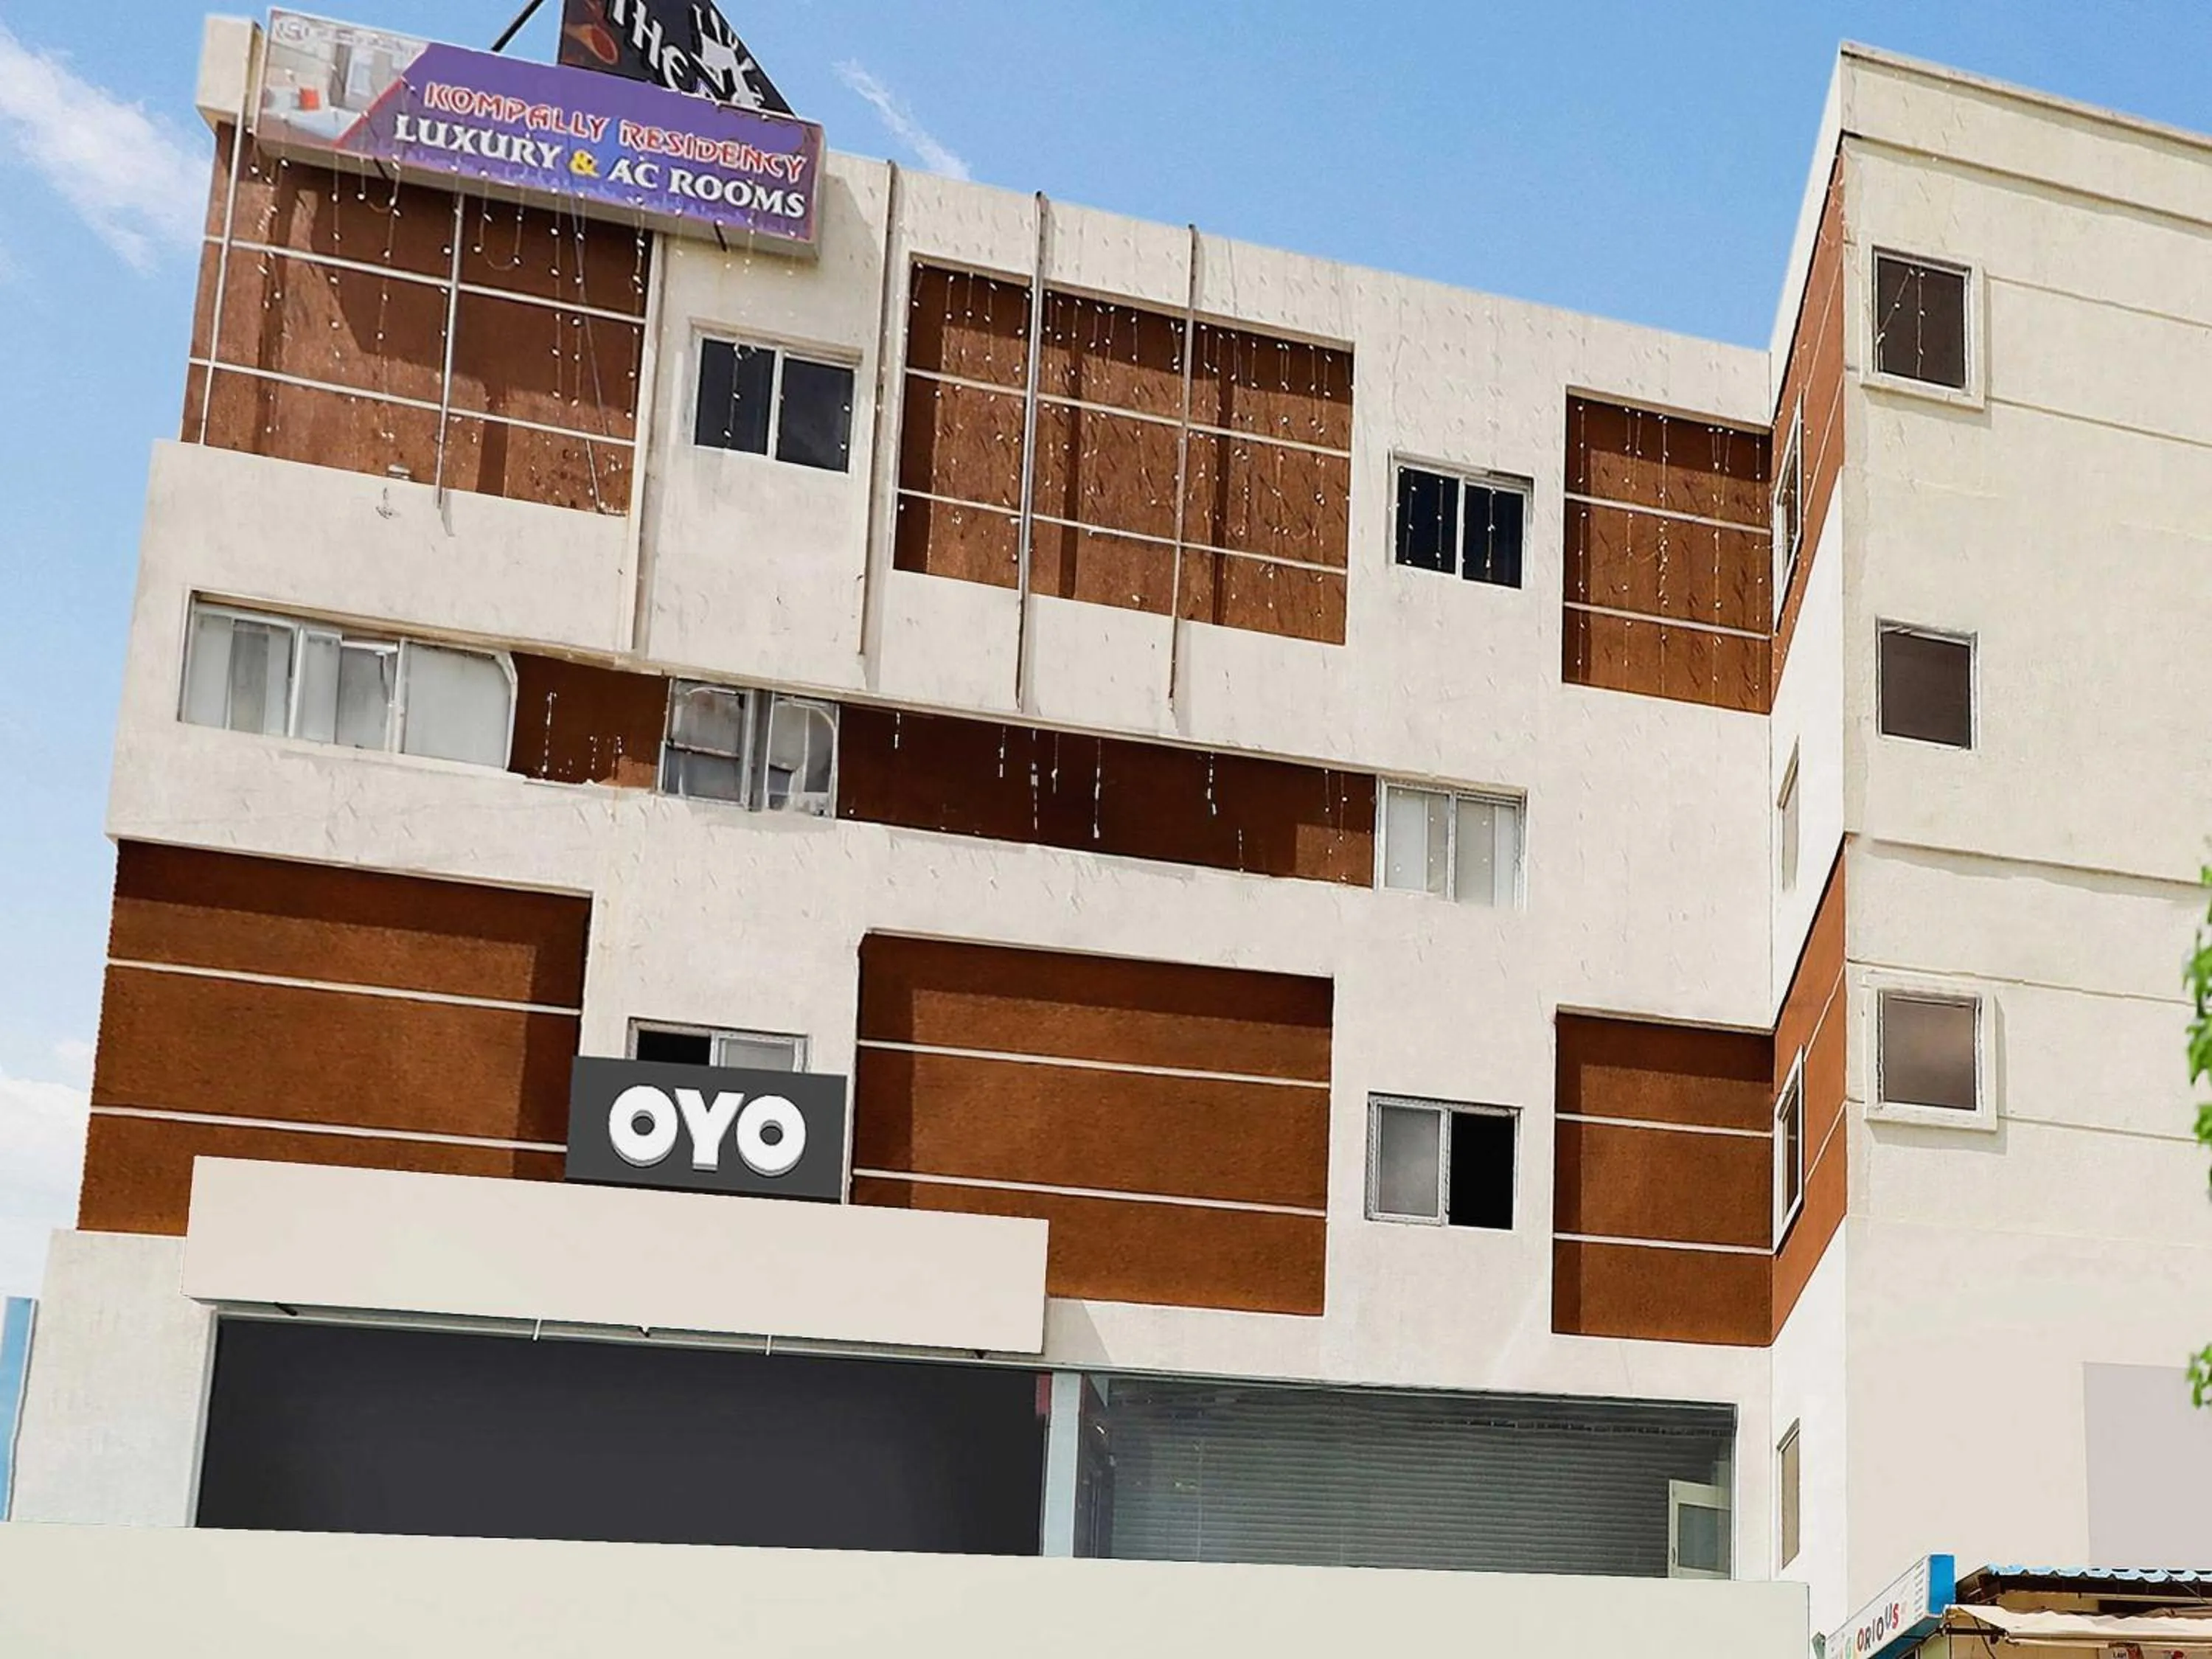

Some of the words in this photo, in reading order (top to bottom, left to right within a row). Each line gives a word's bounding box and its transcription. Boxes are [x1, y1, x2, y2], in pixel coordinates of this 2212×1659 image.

[394, 114, 563, 170] LUXURY
[567, 150, 600, 179] &
[608, 158, 661, 189] AC
[668, 167, 805, 218] ROOMS
[424, 81, 609, 142] KOMPALLY
[619, 119, 807, 184] RESIDENCY
[608, 1085, 807, 1178] OYO
